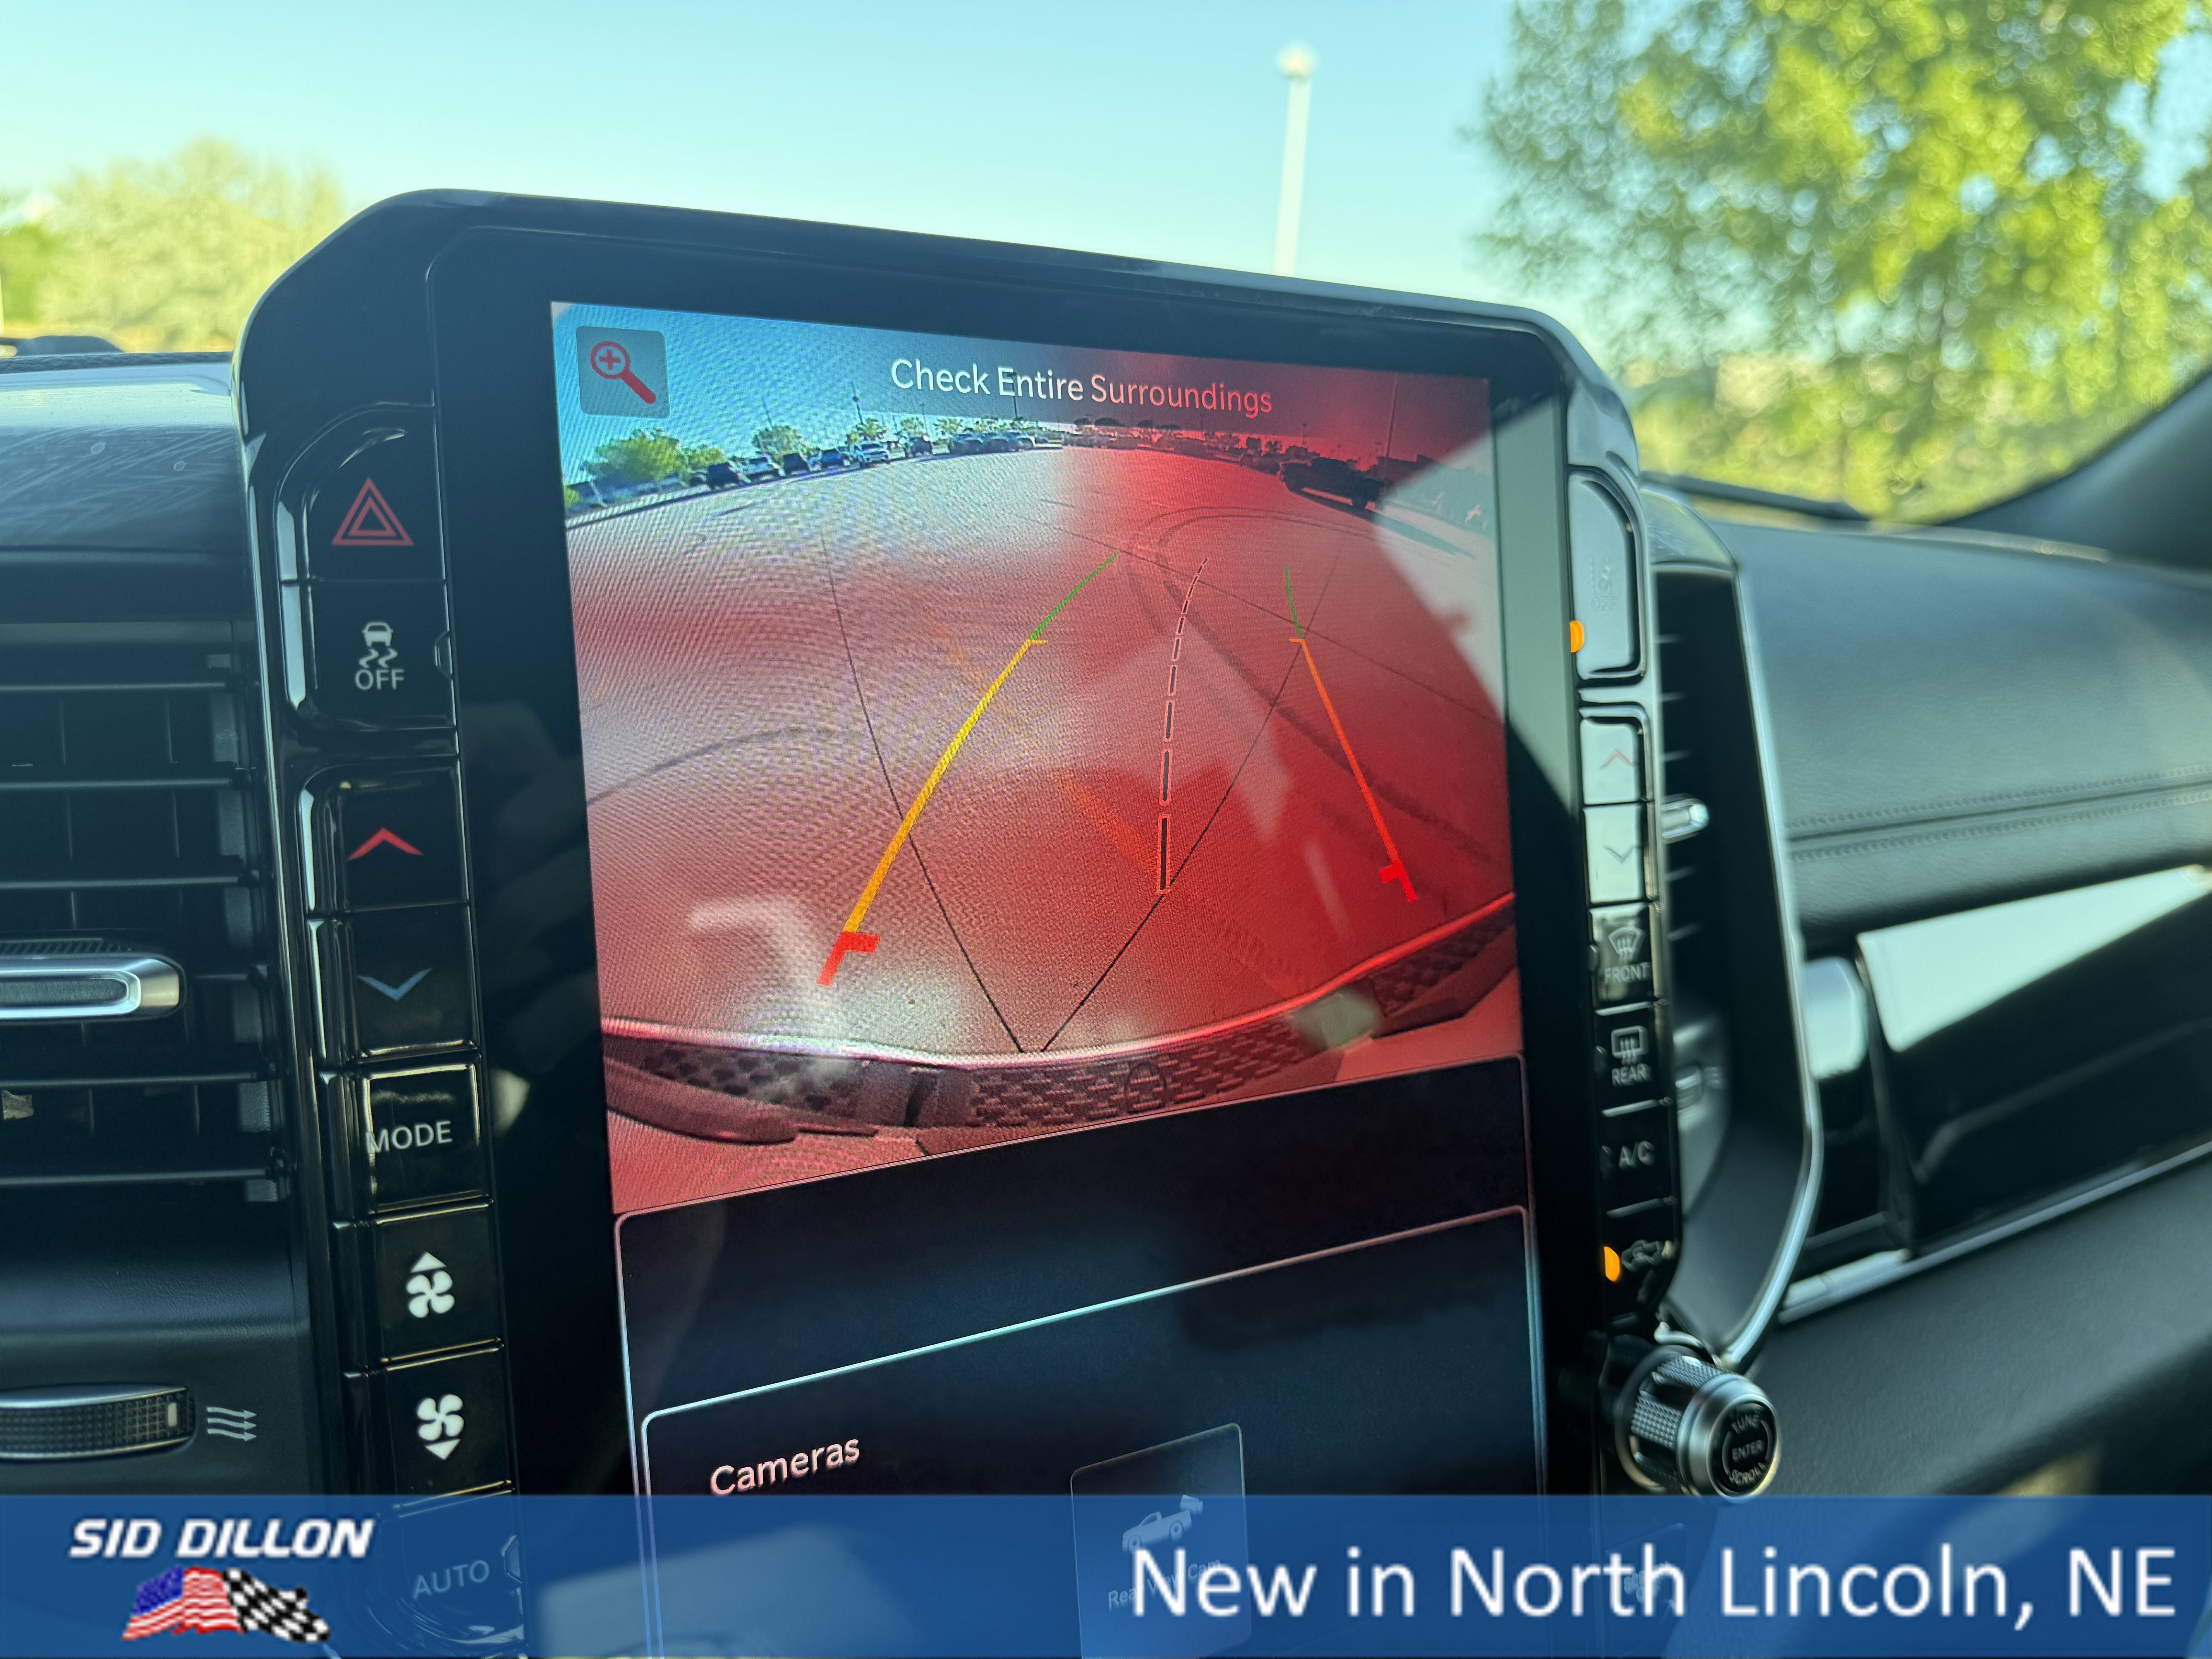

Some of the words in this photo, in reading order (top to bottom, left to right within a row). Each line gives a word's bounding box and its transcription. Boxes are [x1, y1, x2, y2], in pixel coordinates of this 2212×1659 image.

[891, 359, 990, 395] Check
[998, 368, 1083, 400] Entire
[1091, 374, 1273, 419] Surroundings
[355, 669, 405, 690] OFF
[1605, 962, 1651, 984] FRONT
[1612, 1063, 1651, 1087] REAR
[366, 1120, 453, 1154] MODE
[1619, 1140, 1655, 1170] A/C
[1732, 1439, 1765, 1463] ENTER
[710, 1439, 860, 1496] Cameras
[414, 1560, 490, 1599] AUTO
[1108, 1587, 1144, 1610] Rea
